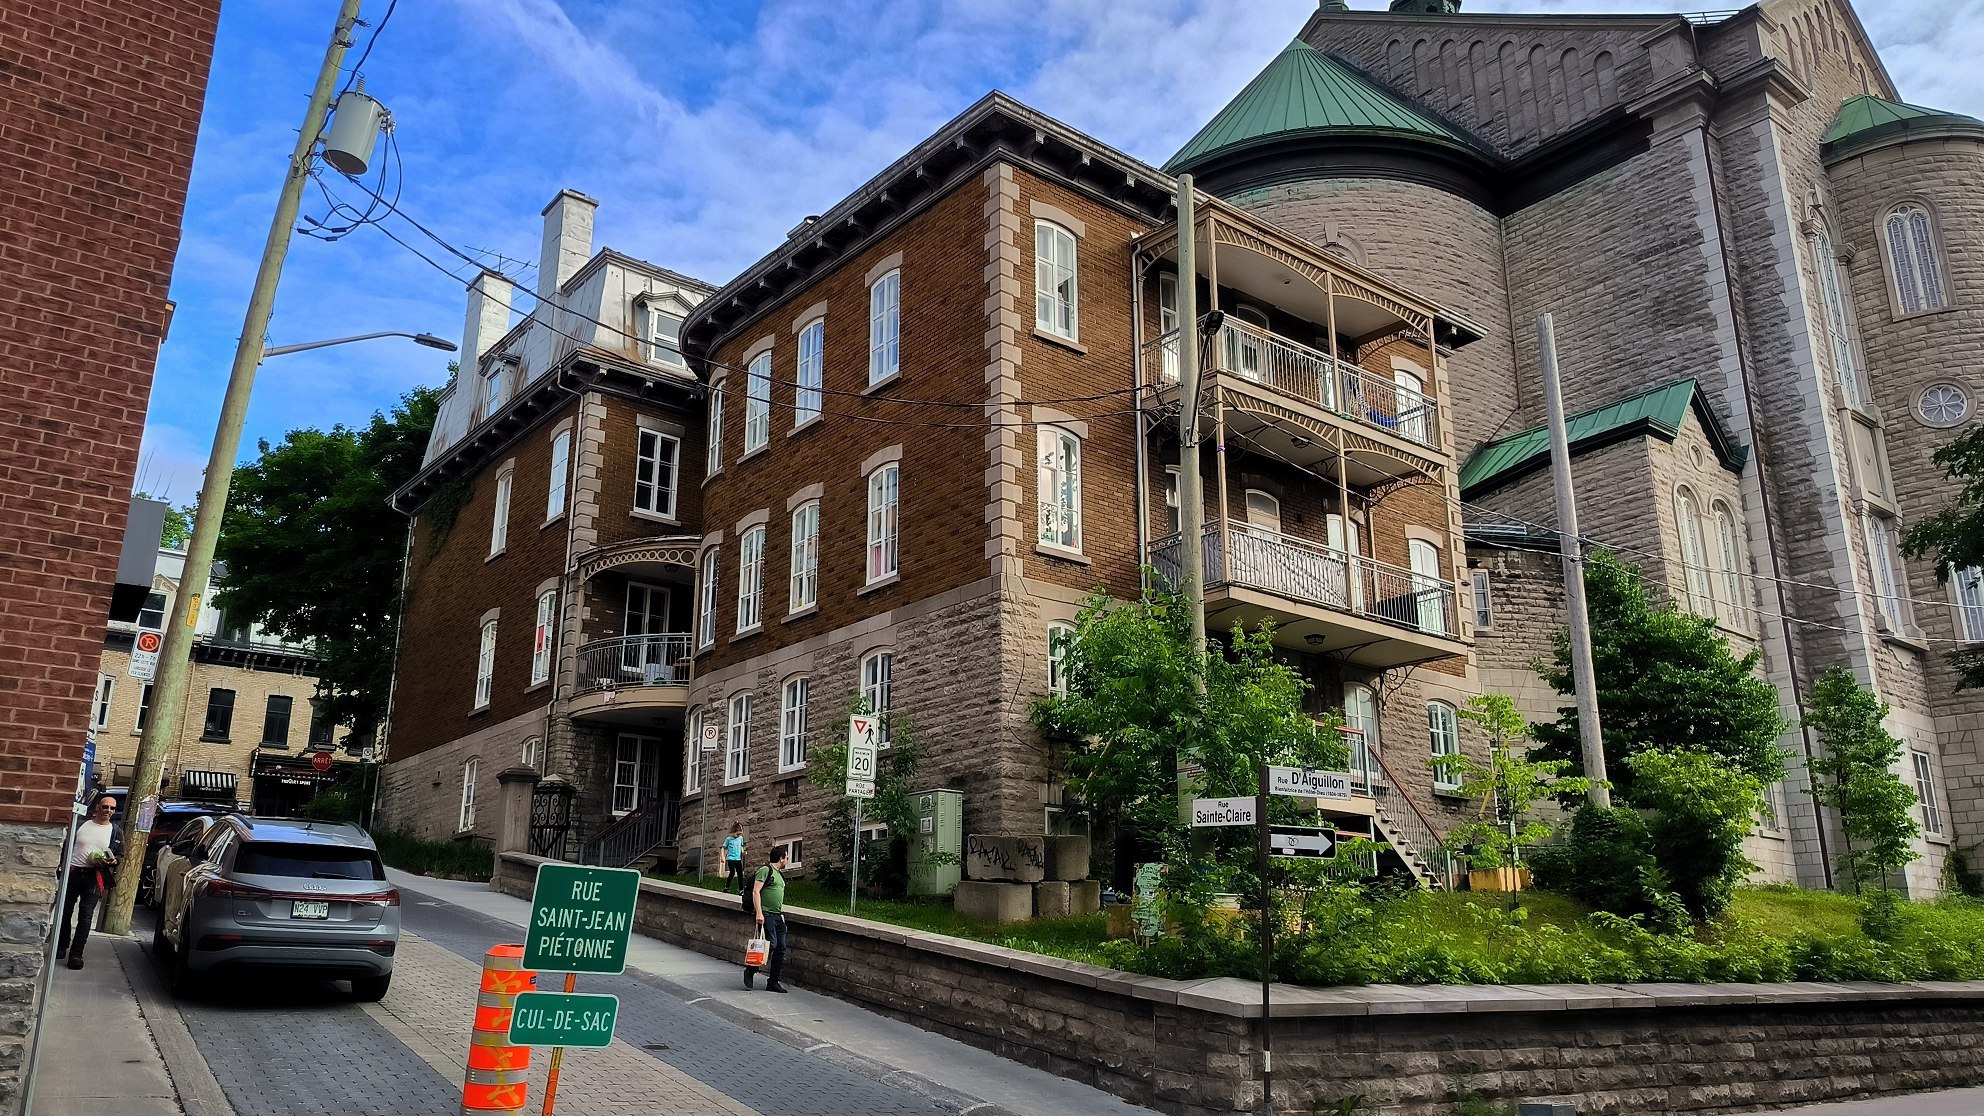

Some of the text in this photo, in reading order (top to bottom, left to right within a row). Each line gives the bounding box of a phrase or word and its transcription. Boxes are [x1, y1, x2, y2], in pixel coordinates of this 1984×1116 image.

[854, 757, 869, 771] 20
[1277, 771, 1345, 790] Rue D'Aiguillon
[1196, 808, 1251, 824] Sainte-Claire
[571, 880, 603, 901] RUE
[537, 906, 627, 932] SAINT-JEAN
[538, 932, 615, 959] PIÉTONNE
[516, 1008, 611, 1032] CUL-DE-SAC
